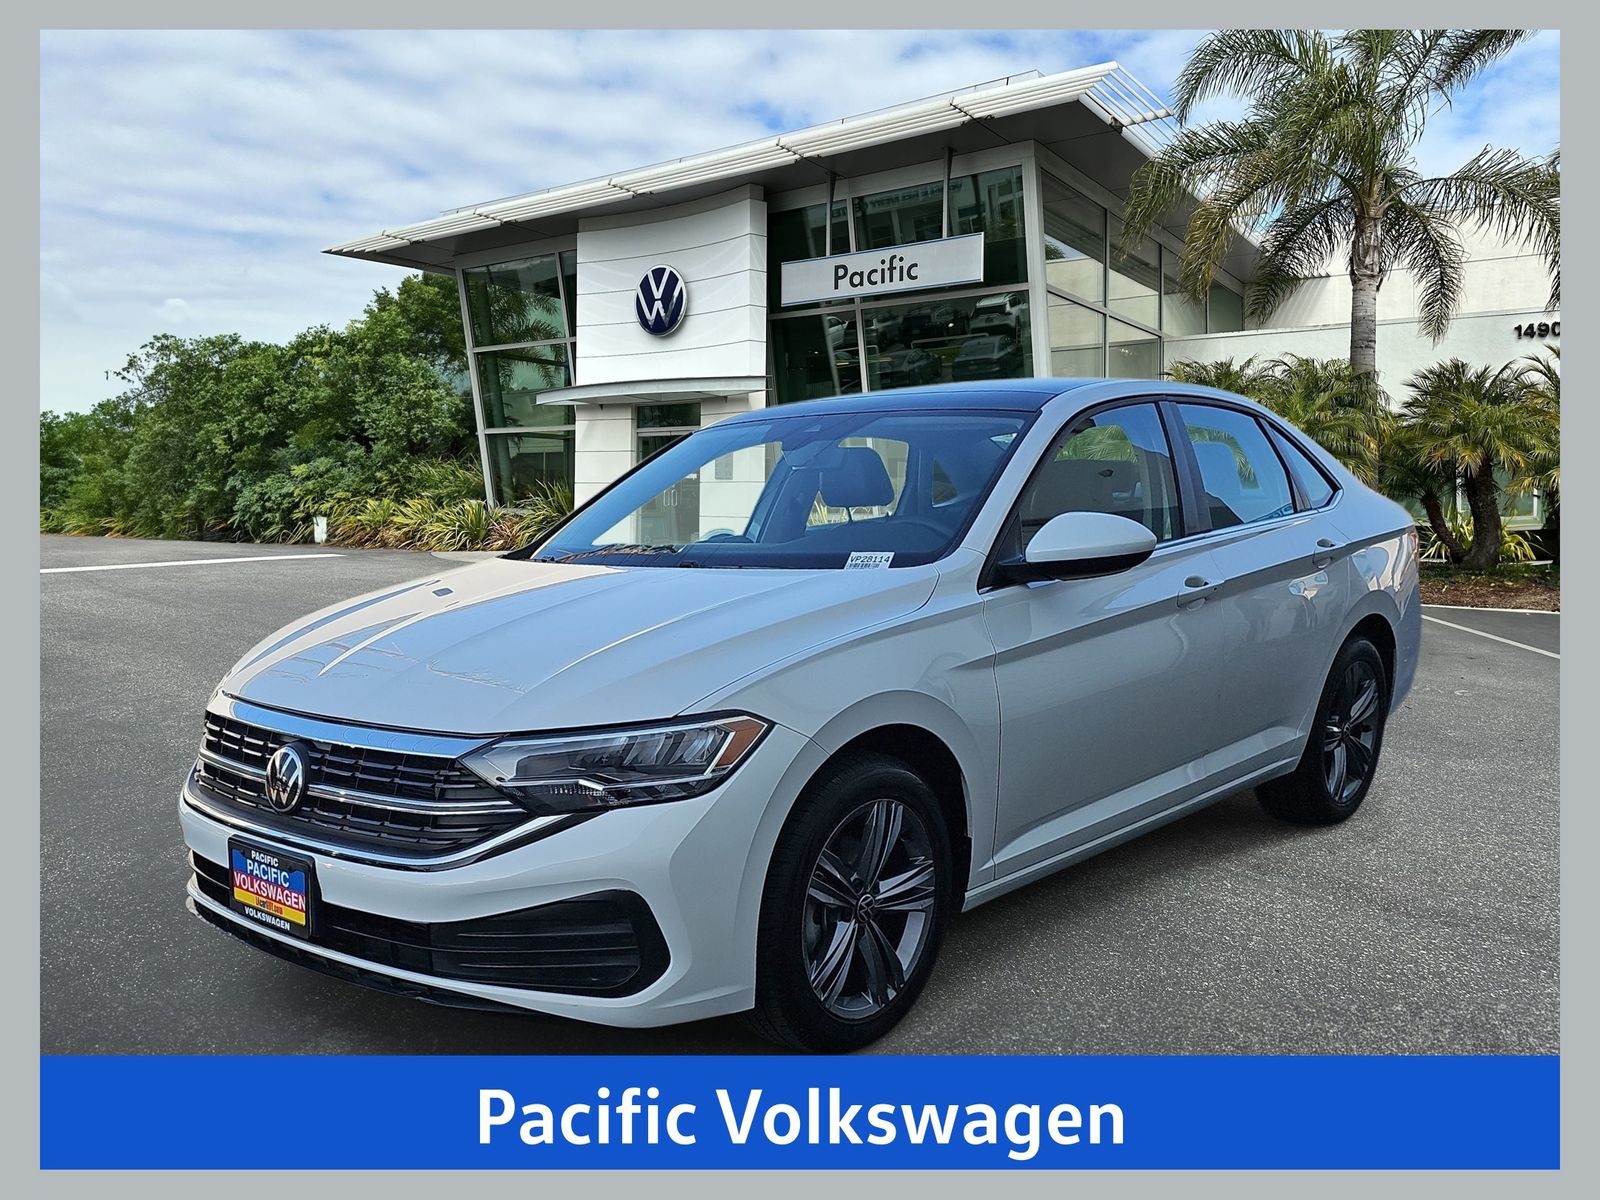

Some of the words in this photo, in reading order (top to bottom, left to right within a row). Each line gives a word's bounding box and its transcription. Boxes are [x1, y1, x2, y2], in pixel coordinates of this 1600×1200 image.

[834, 254, 918, 290] Pacific
[636, 265, 687, 336] VW
[1514, 321, 1560, 339] 1490
[850, 555, 891, 563] VP28114
[265, 746, 303, 812] VW
[246, 858, 290, 888] PACIFIC
[251, 850, 279, 867] PACIFIC
[233, 871, 306, 911] VOLKSWAGEN
[244, 905, 290, 931] VOLKSWAGEN
